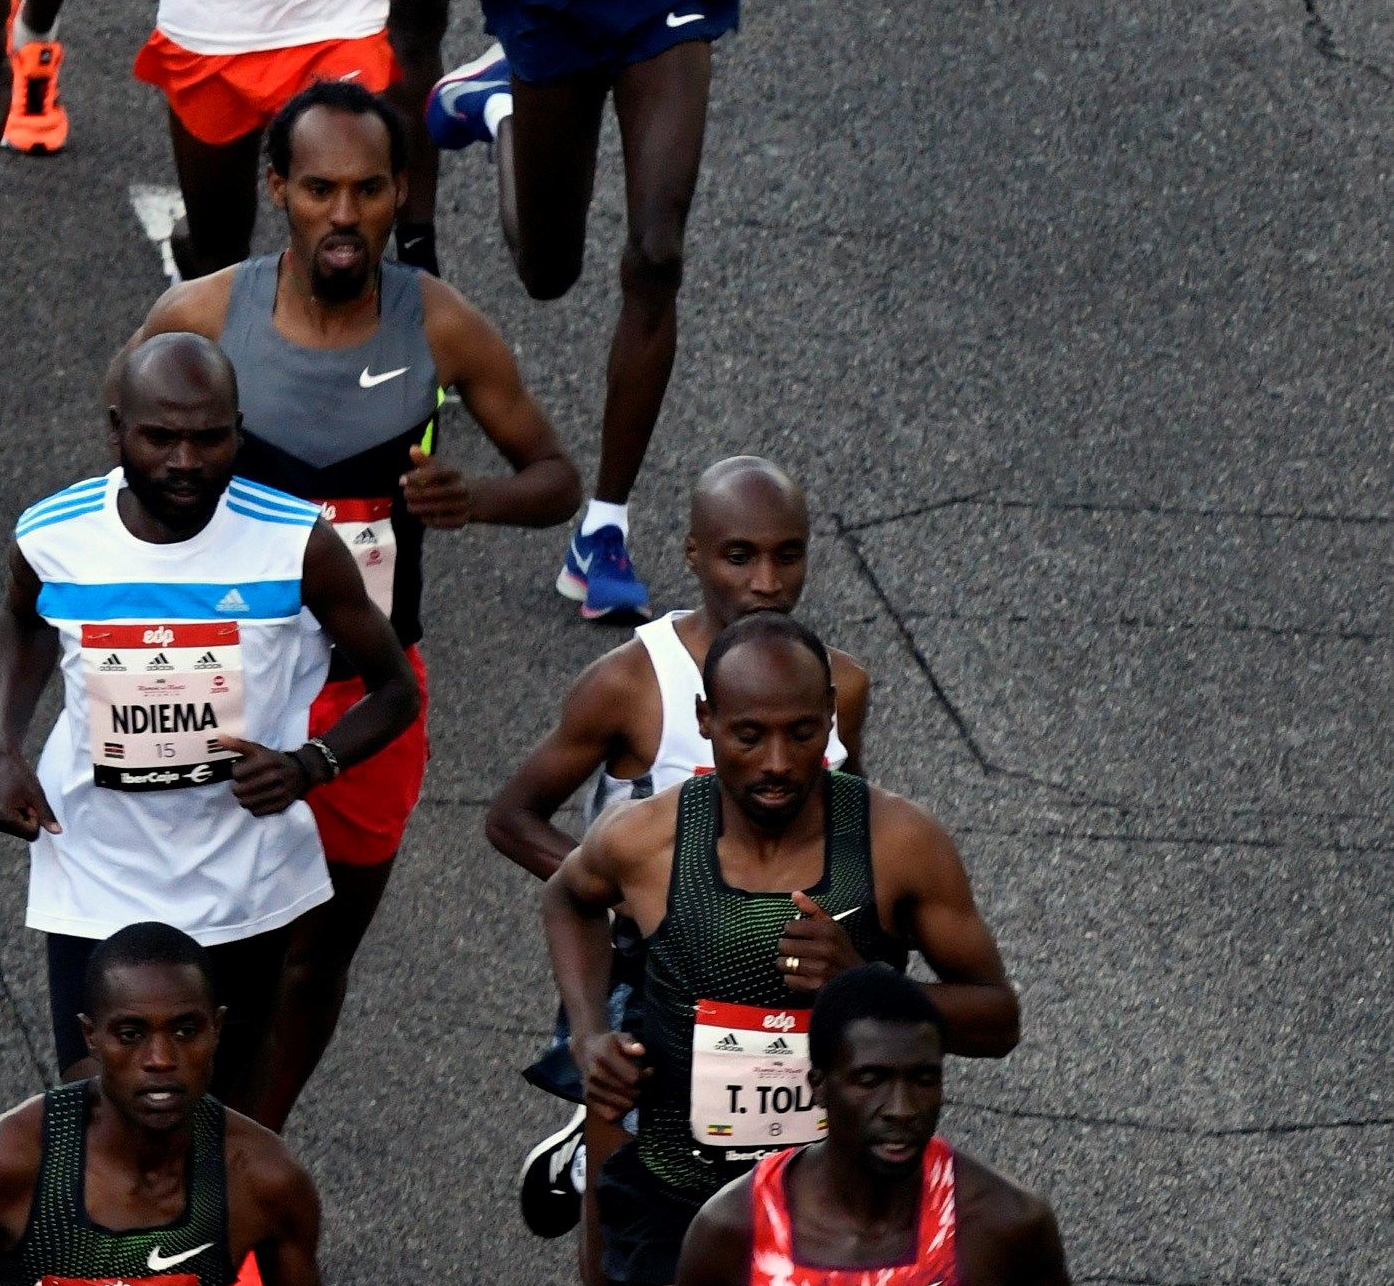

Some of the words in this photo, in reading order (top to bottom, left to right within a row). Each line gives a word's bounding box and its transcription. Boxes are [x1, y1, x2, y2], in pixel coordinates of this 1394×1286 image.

[142, 625, 175, 647] edp
[111, 702, 219, 735] NDIEMA
[155, 742, 176, 759] 15
[762, 1011, 796, 1032] edp
[726, 1085, 748, 1114] T.
[769, 1122, 783, 1137] 8
